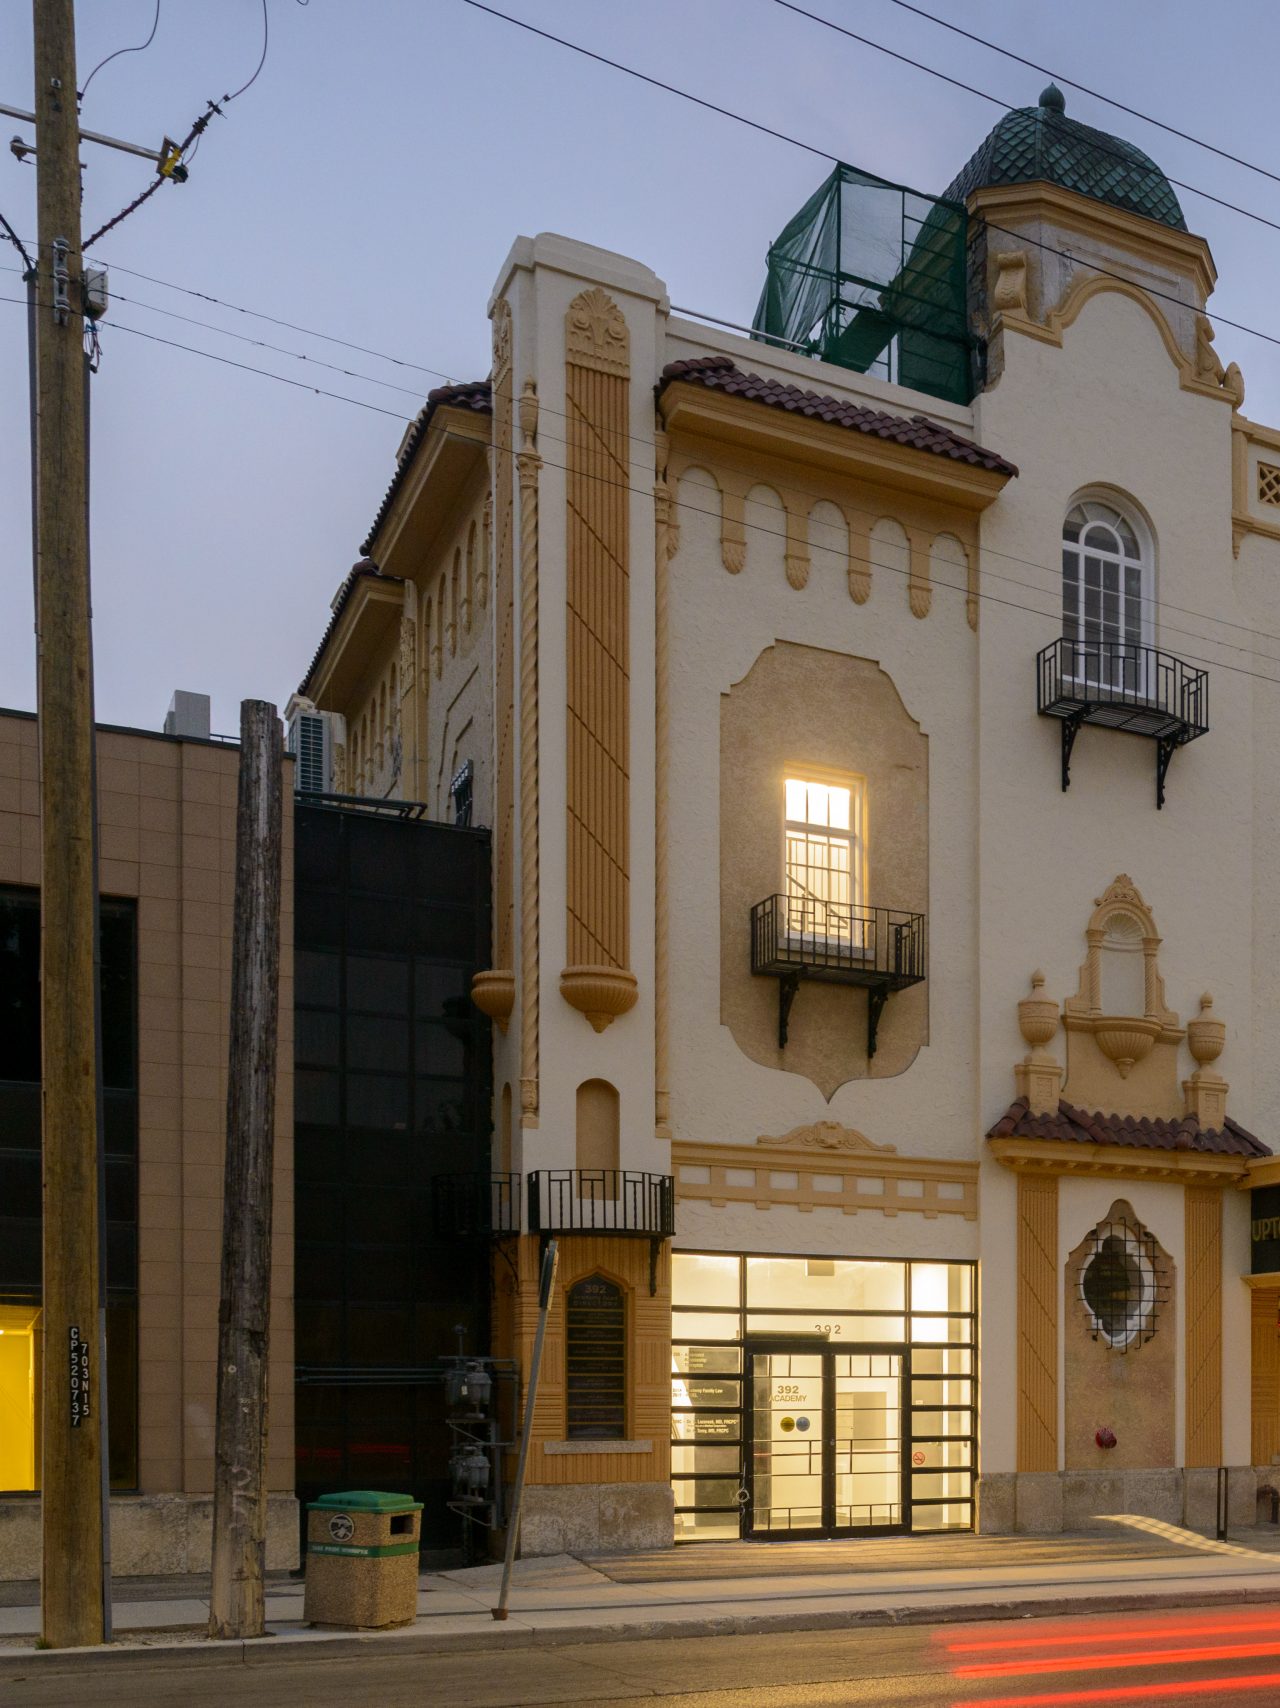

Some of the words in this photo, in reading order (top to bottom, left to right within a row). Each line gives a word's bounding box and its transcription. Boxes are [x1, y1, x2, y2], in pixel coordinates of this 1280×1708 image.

[584, 1284, 608, 1294] 392
[815, 1324, 841, 1335] 392
[71, 1328, 80, 1426] CP520737
[81, 1344, 89, 1415] 703N15
[777, 1385, 800, 1395] 392
[768, 1394, 808, 1402] ACADEMY
